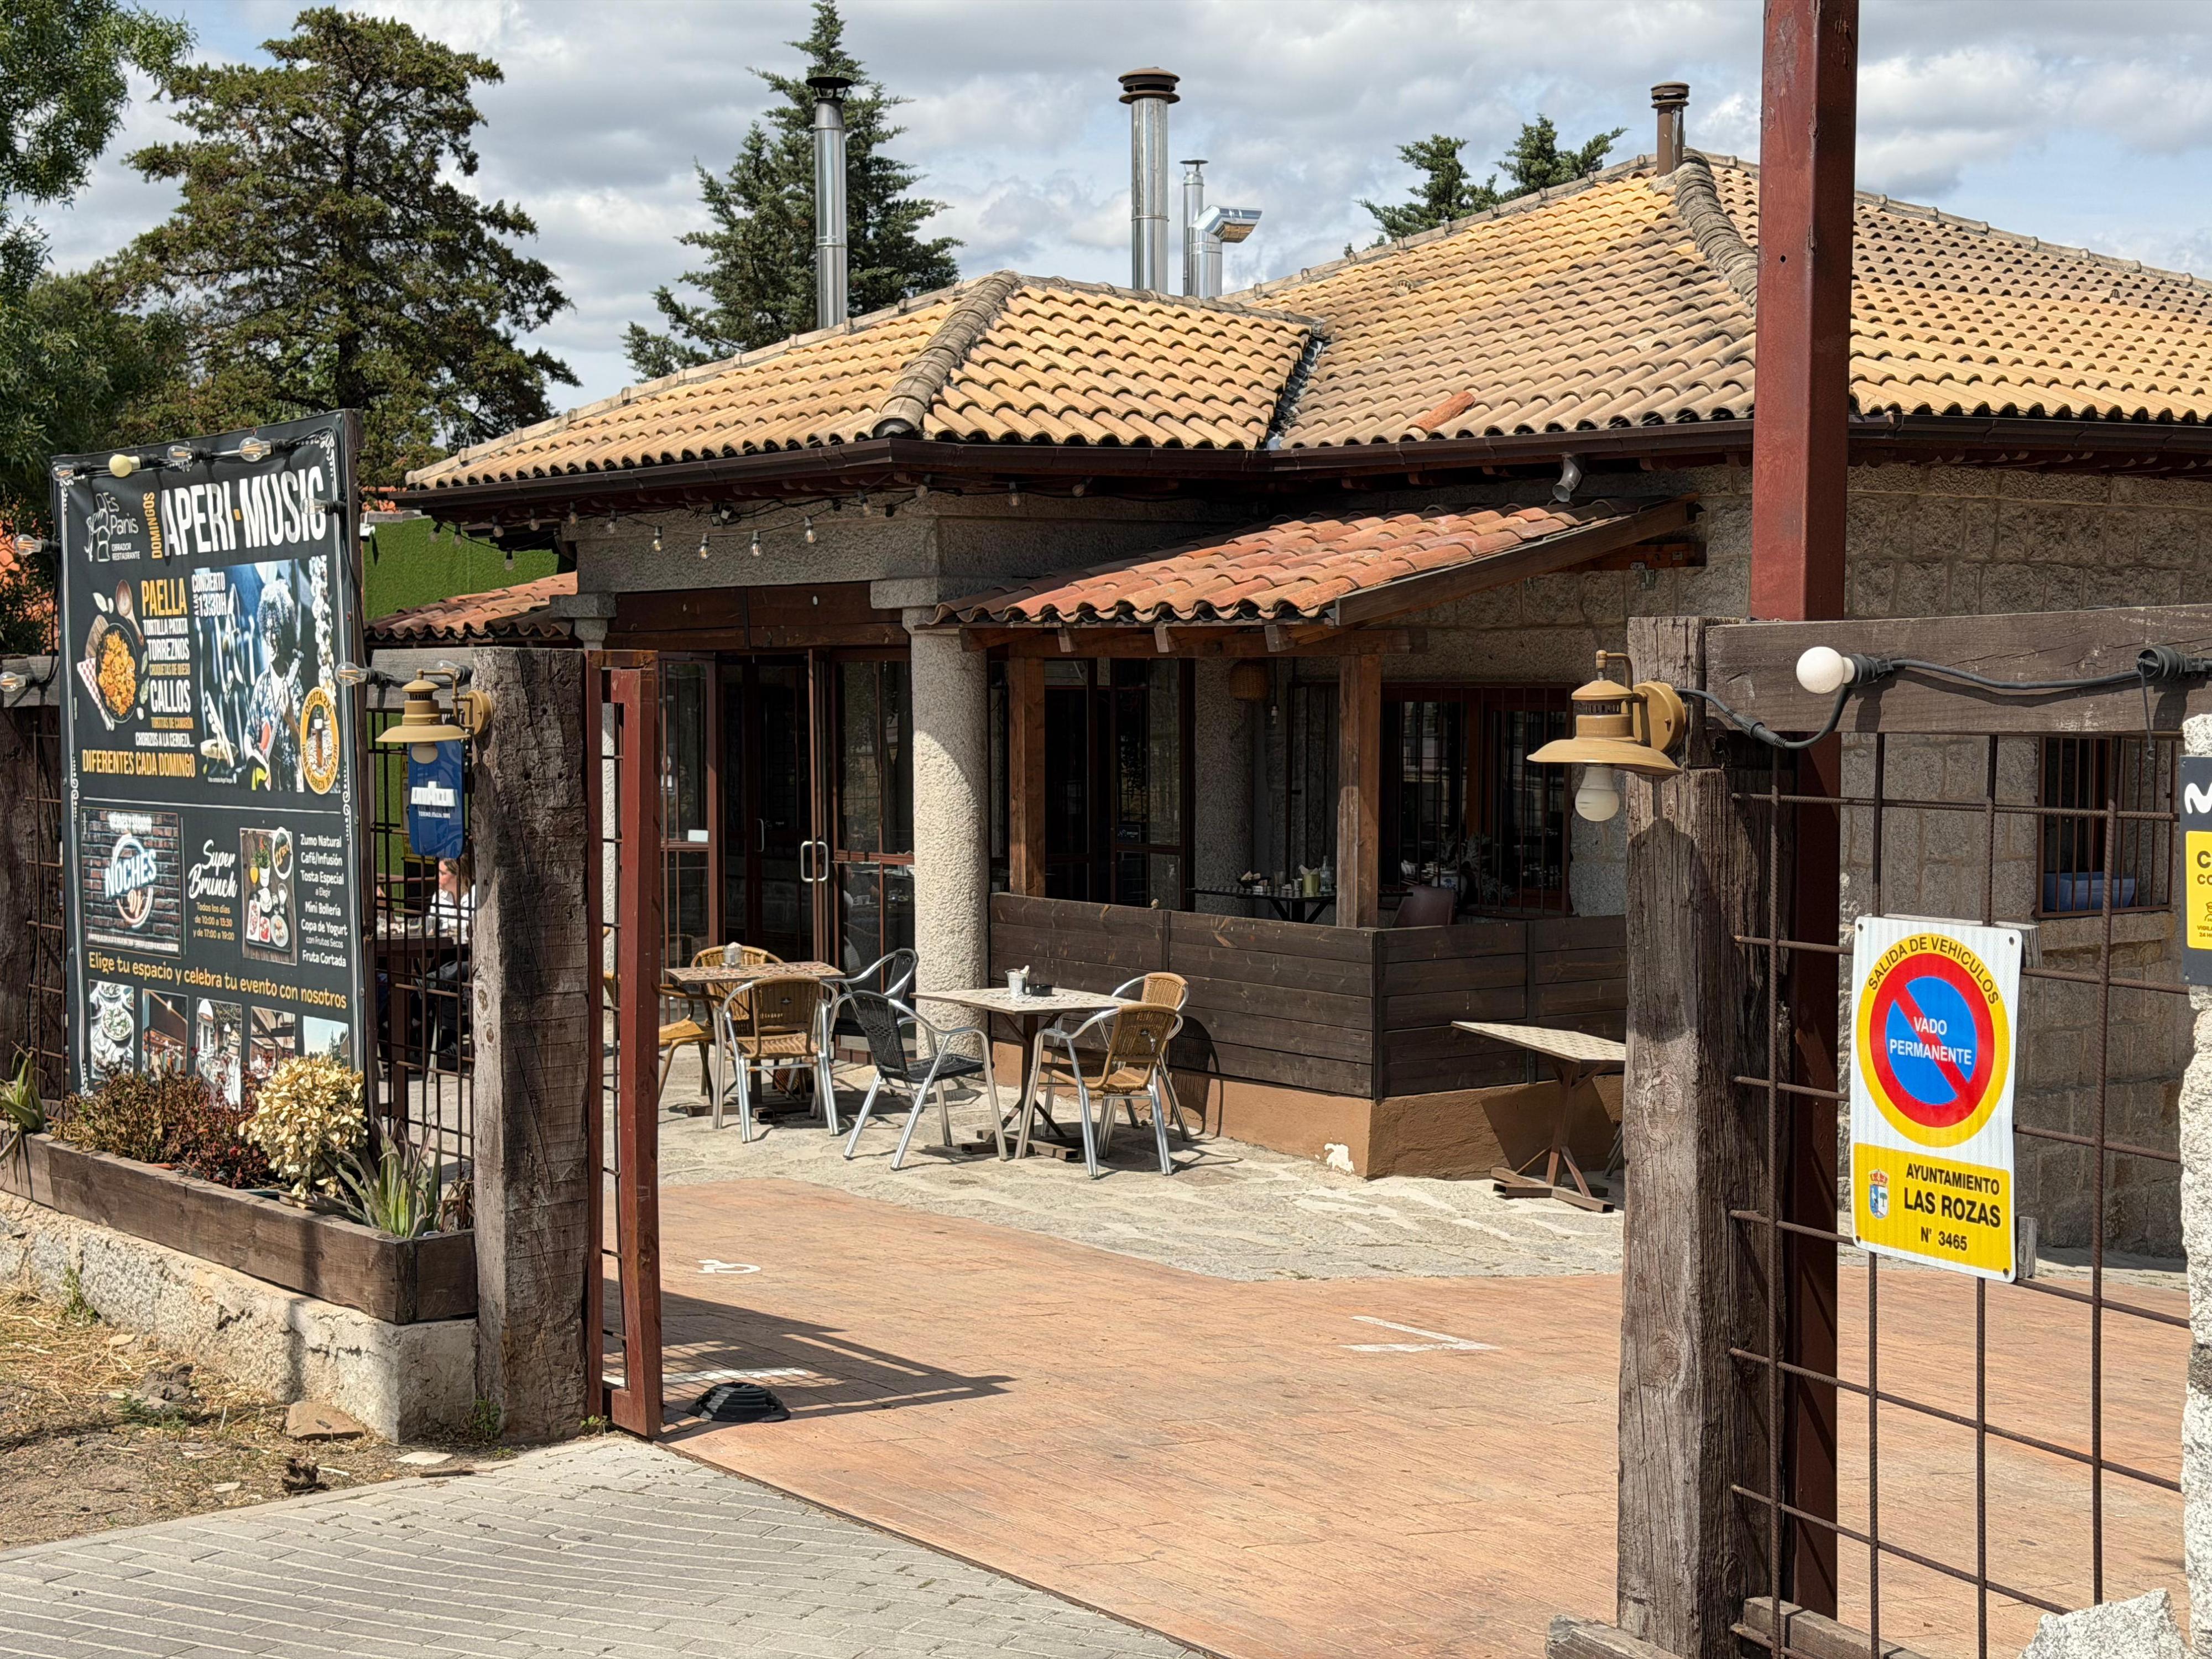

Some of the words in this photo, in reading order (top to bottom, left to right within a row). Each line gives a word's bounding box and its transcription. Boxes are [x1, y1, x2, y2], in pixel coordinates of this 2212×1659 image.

[110, 513, 139, 535] Panis
[143, 492, 163, 559] DOMINGOS
[191, 572, 226, 593] CONCIERTO
[141, 577, 187, 617] PAELLA
[199, 592, 227, 617] 13:30H
[143, 619, 168, 636] TORTILLA
[169, 618, 189, 635] PATATA
[147, 638, 190, 661] TORREZNOS
[150, 679, 191, 713] CALLOS
[135, 732, 159, 747] CHORIZOS
[163, 733, 169, 747] LA
[82, 749, 134, 775] DIFERENTES
[135, 752, 158, 776] CADA
[158, 753, 195, 778] DOMINGO
[300, 833, 317, 846] Zumo
[318, 834, 342, 848] Natural
[202, 839, 236, 877] Super
[105, 849, 156, 899] NOCHES
[187, 863, 238, 899] Brunch
[300, 870, 319, 883] Tosta
[319, 871, 344, 886] Especial
[305, 900, 318, 914] Mini
[319, 902, 341, 916] Bollería
[301, 919, 317, 933] Copa
[318, 920, 325, 933] de
[326, 921, 348, 937] Yogurt
[330, 937, 344, 949] Secos
[302, 950, 320, 963] Fruta
[320, 952, 347, 968] Cortada
[1868, 943, 1908, 990] SALIDA
[1909, 936, 1928, 952] DE
[1931, 937, 1999, 1005] VEHICULOS
[88, 951, 115, 974] Elige
[116, 956, 130, 973] tu
[132, 961, 173, 981] espacio
[175, 968, 182, 987] y
[184, 967, 222, 988] celebra
[225, 972, 238, 990] tu
[239, 978, 278, 997] evento
[279, 984, 298, 1001] con
[300, 988, 347, 1009] nosotros
[1913, 1016, 1948, 1035] VADO
[1890, 1039, 1973, 1065] PERMANENTE
[1906, 1162, 2000, 1196] AYUNTAMIENTO
[1904, 1187, 1936, 1214] LAS
[1941, 1194, 2001, 1228] ROZAS
[1938, 1230, 1968, 1251] 3465
